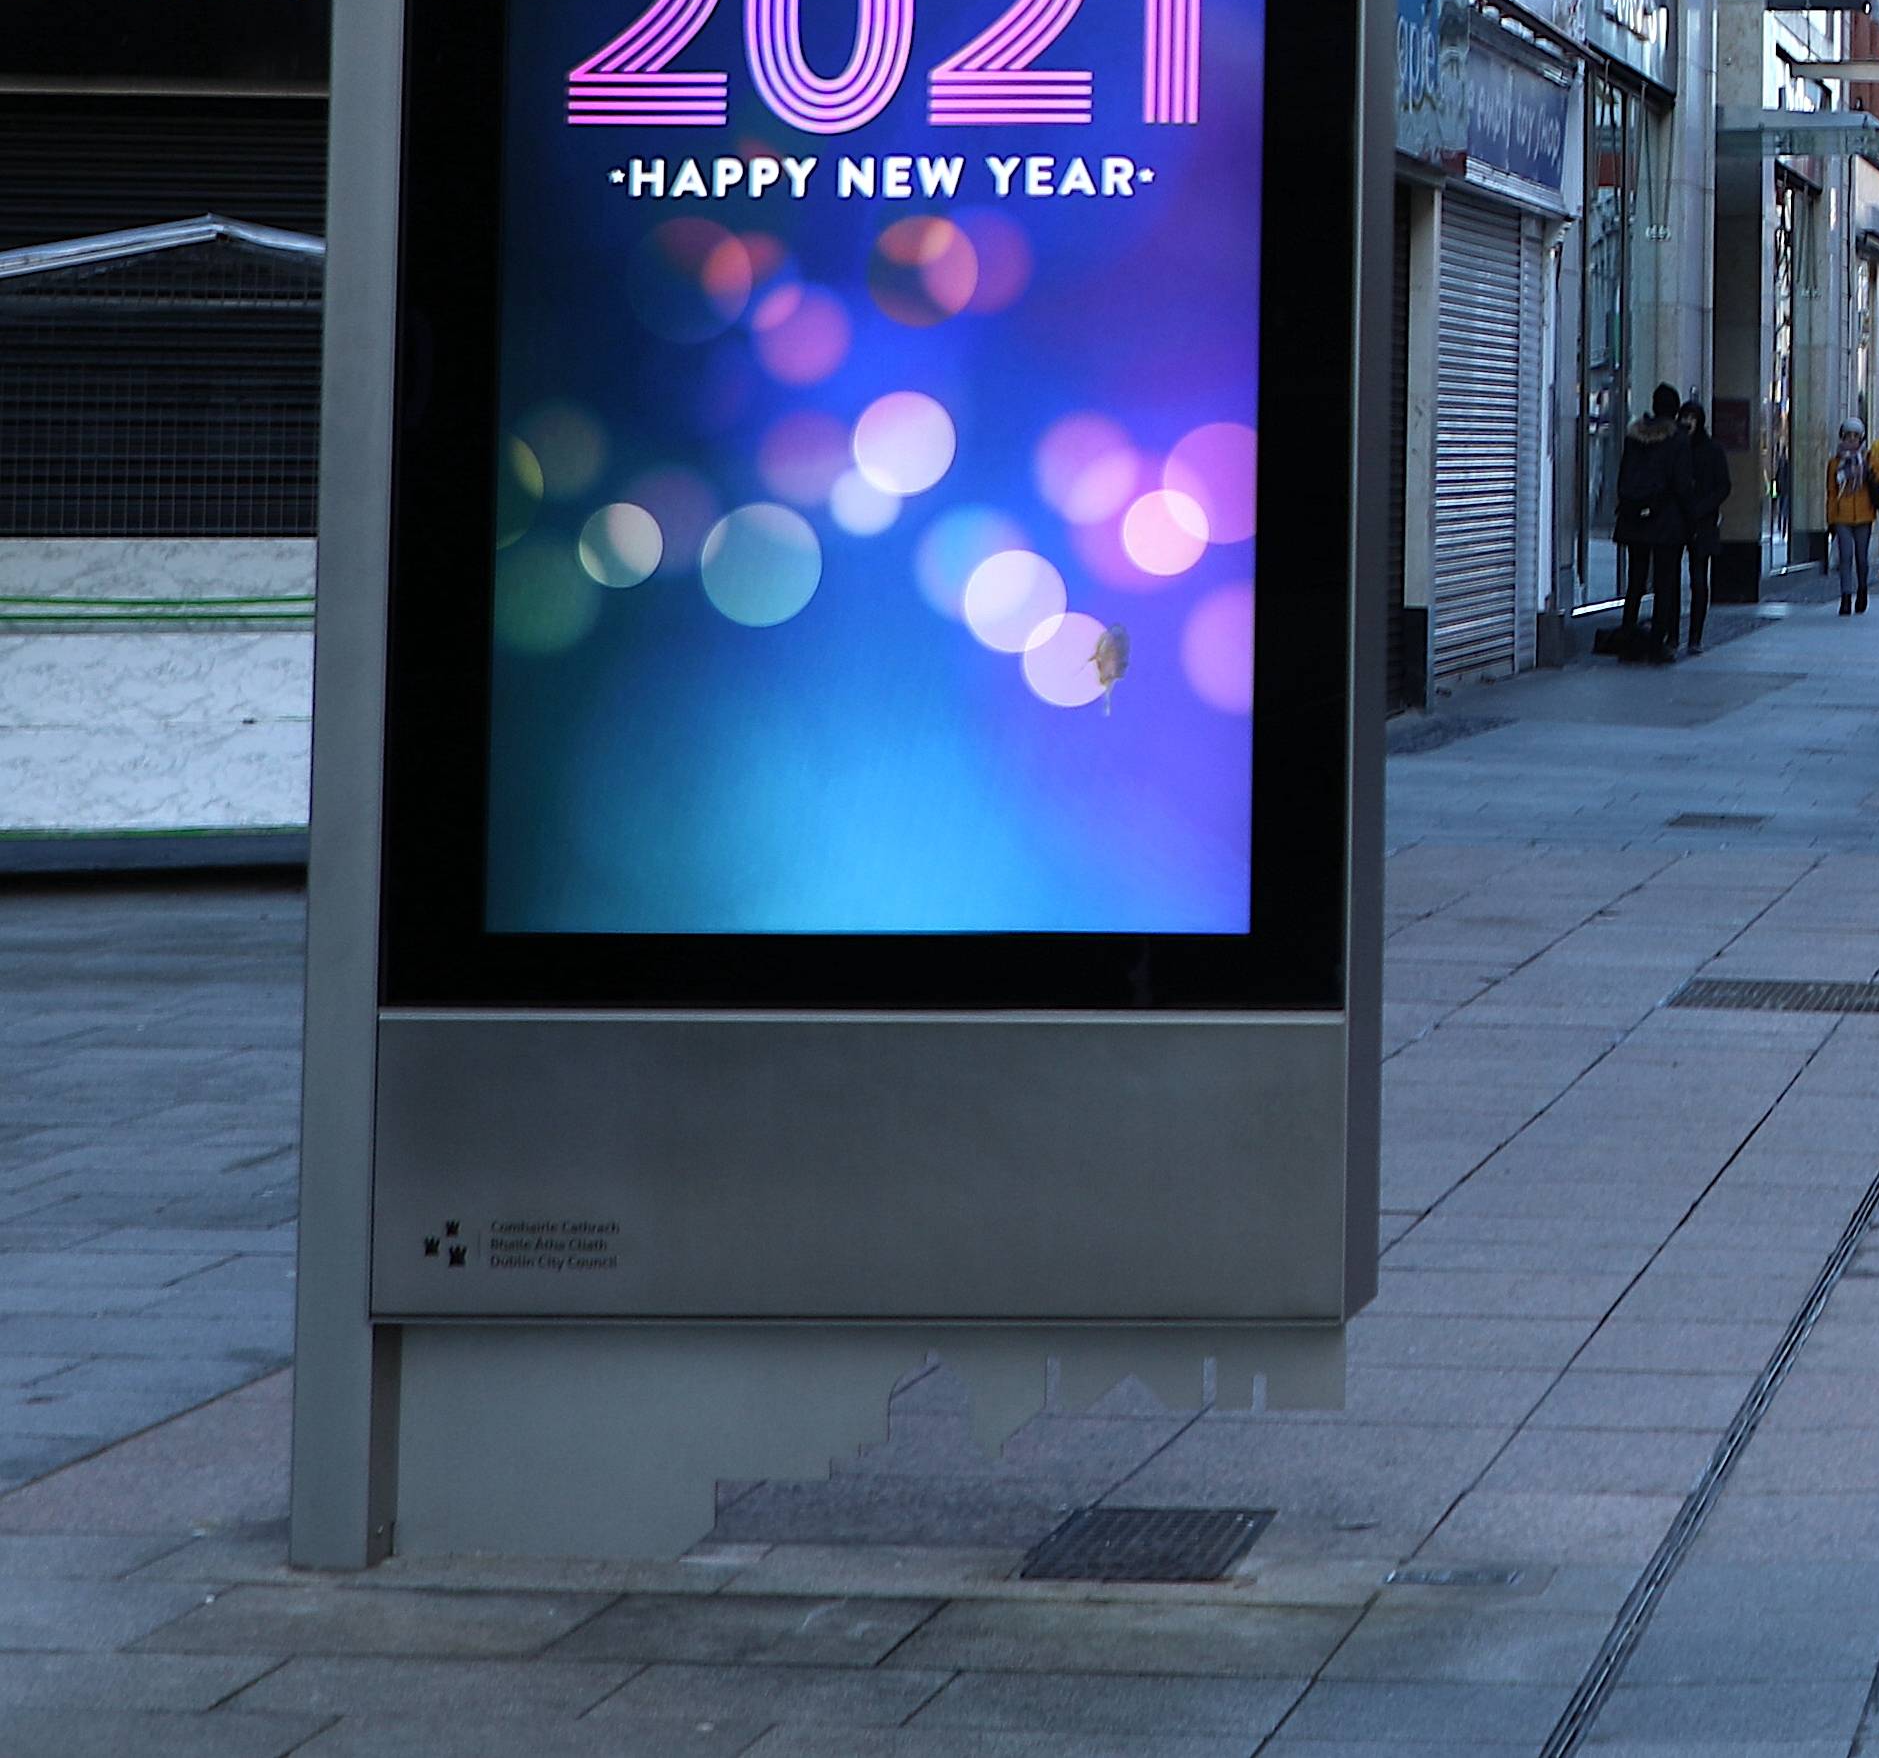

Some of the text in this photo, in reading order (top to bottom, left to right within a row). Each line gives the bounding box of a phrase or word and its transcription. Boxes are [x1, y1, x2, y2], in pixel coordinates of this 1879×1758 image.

[628, 154, 1135, 199] HAPPY NEW YEAR
[537, 1255, 564, 1272] City
